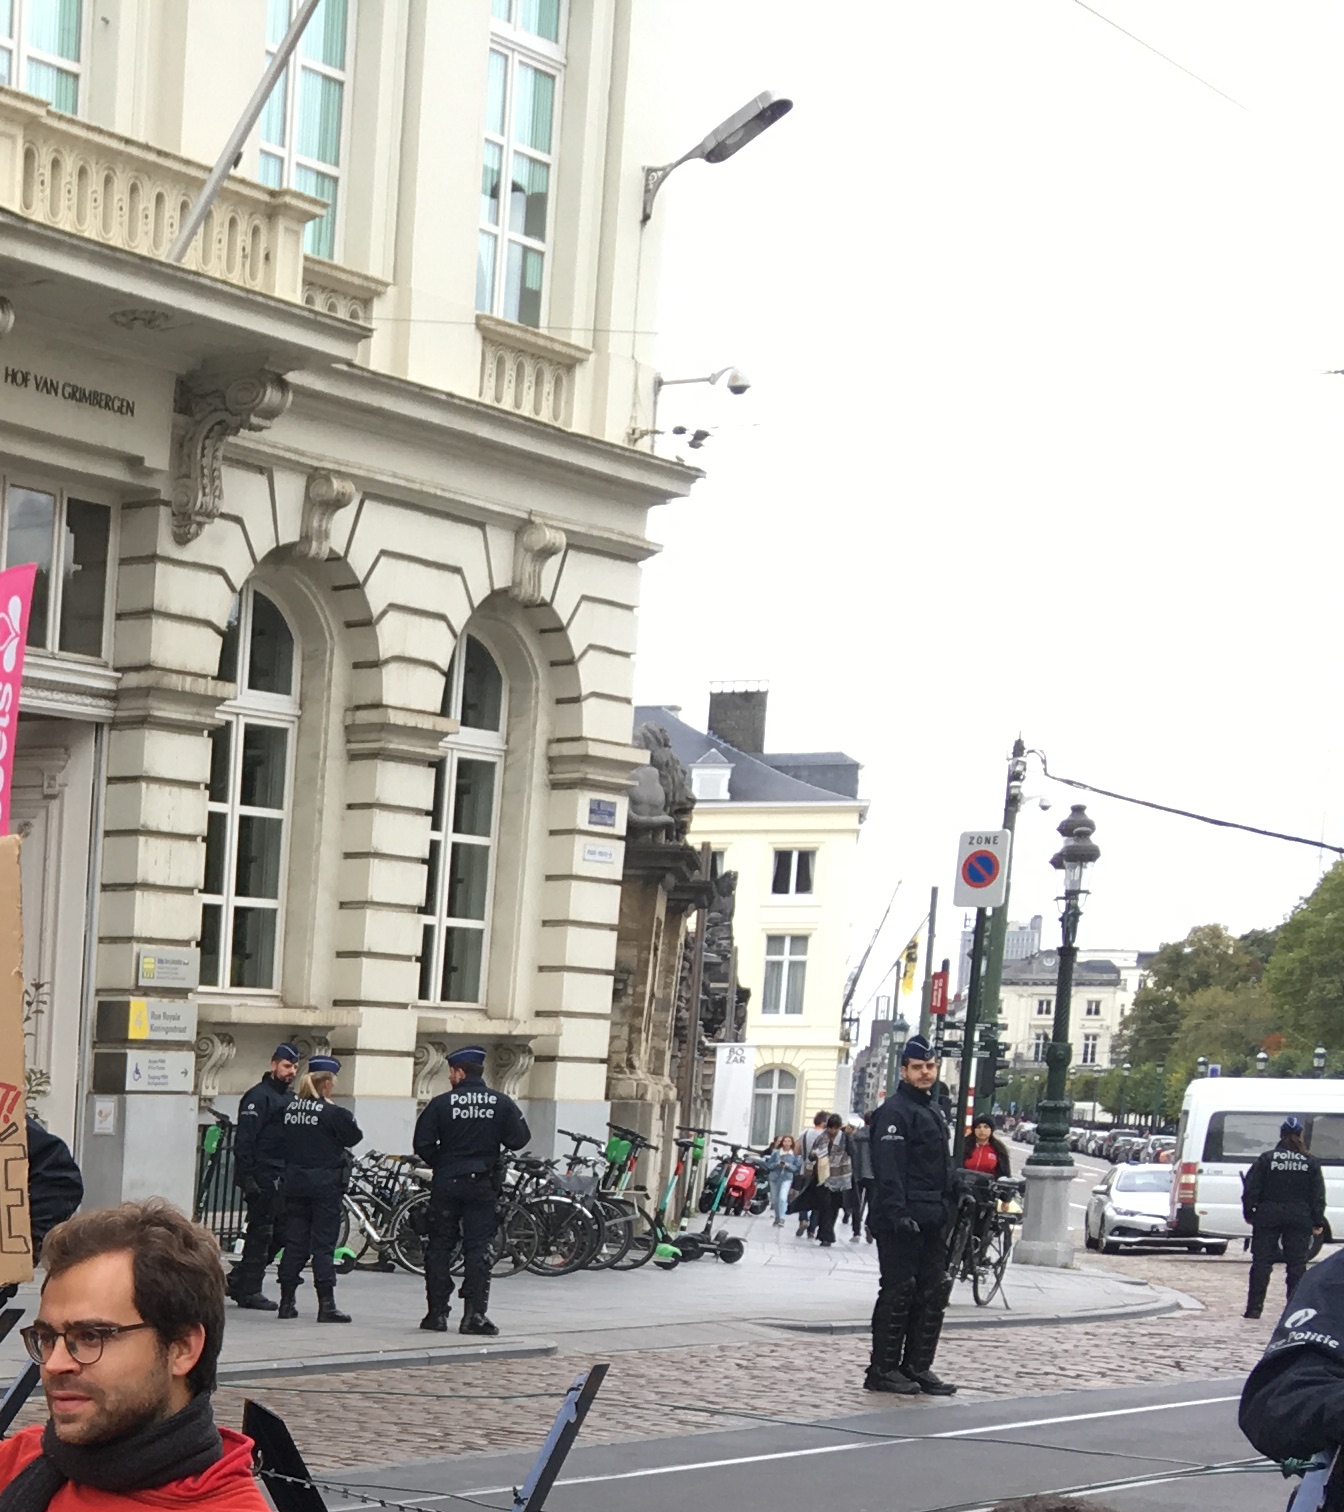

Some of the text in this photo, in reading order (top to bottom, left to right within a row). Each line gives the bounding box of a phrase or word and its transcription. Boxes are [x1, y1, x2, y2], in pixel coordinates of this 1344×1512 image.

[4, 366, 135, 417] HOF VAN GRIMBERGEN
[968, 835, 1000, 846] ZONE
[450, 1092, 498, 1105] Politie
[284, 1112, 319, 1125] Police
[452, 1106, 495, 1119] Police
[1271, 1161, 1309, 1171] Politie
[1288, 1331, 1340, 1349] Politie
